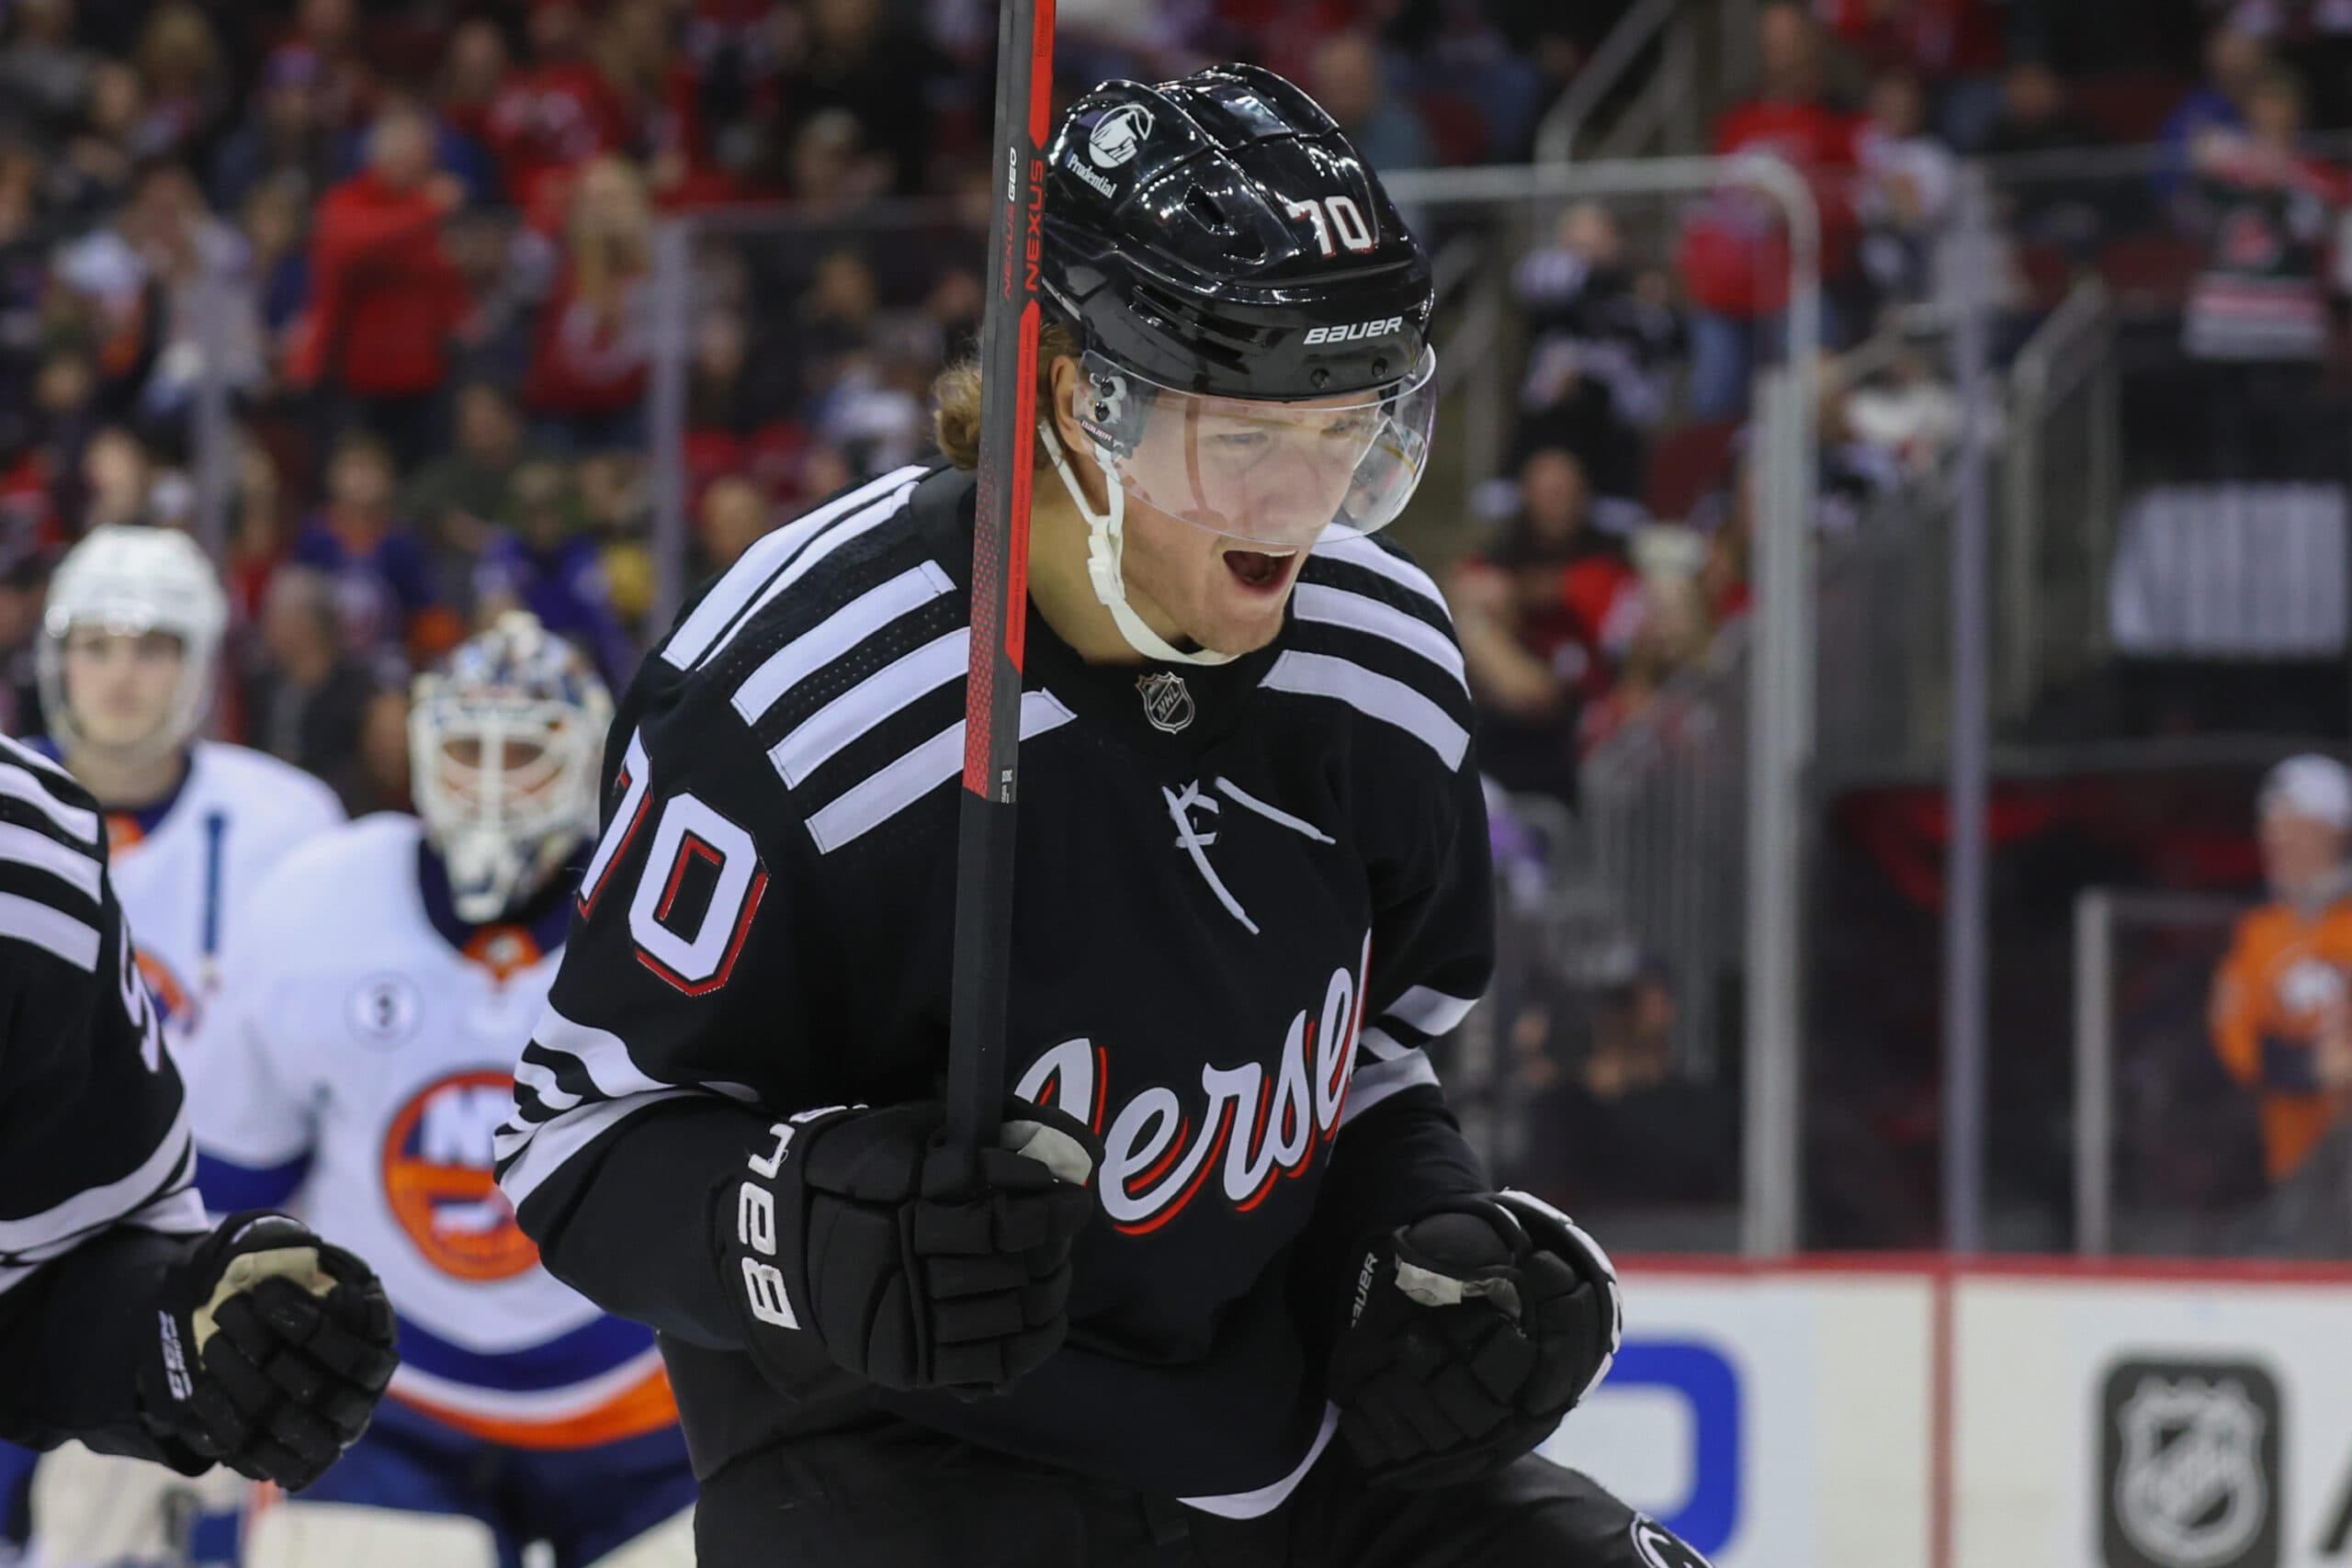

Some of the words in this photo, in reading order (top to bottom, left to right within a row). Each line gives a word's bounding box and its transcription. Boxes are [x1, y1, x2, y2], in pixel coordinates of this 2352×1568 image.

[1008, 146, 1017, 202] GEO
[1067, 152, 1117, 199] Prudential
[1024, 158, 1045, 292] NEXUS
[1286, 196, 1376, 259] 70
[1303, 316, 1403, 345] BAUER
[577, 724, 772, 998] 70
[738, 1103, 869, 1330] BAU
